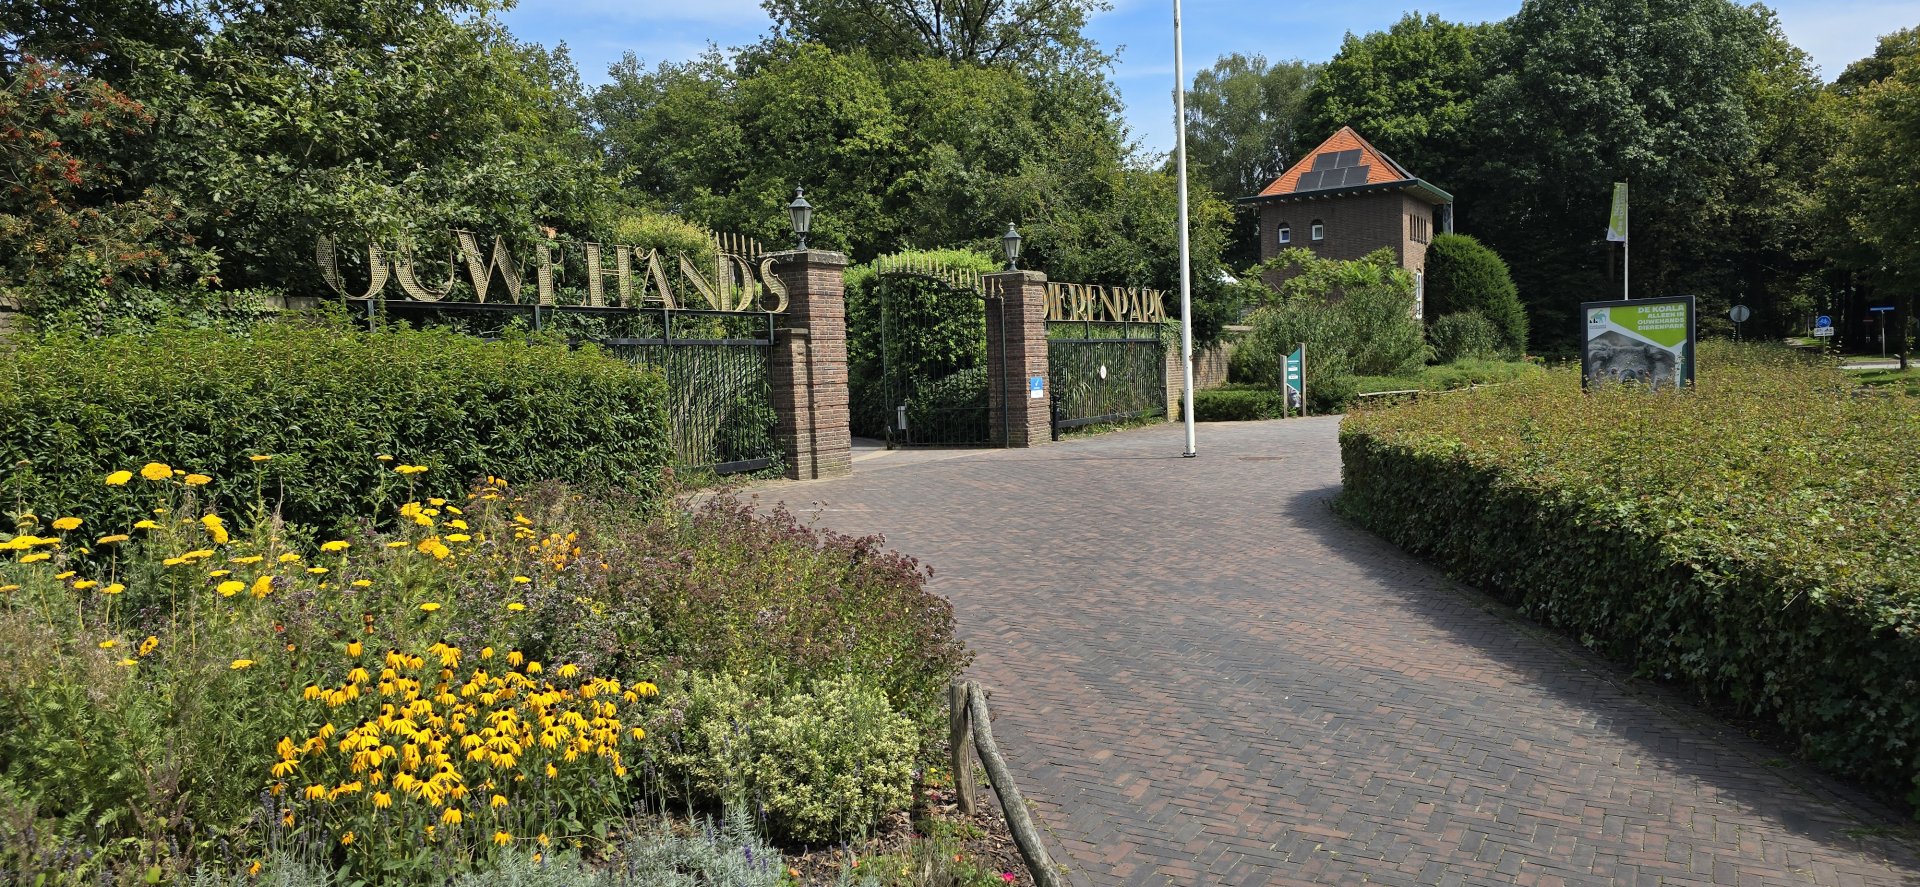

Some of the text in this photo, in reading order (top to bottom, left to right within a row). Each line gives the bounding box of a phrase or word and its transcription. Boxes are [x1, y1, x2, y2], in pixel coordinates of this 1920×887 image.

[1638, 304, 1684, 314] DE KOALA
[1637, 317, 1685, 325] OUWEHANDS
[1638, 323, 1685, 331] DIERENPARK
